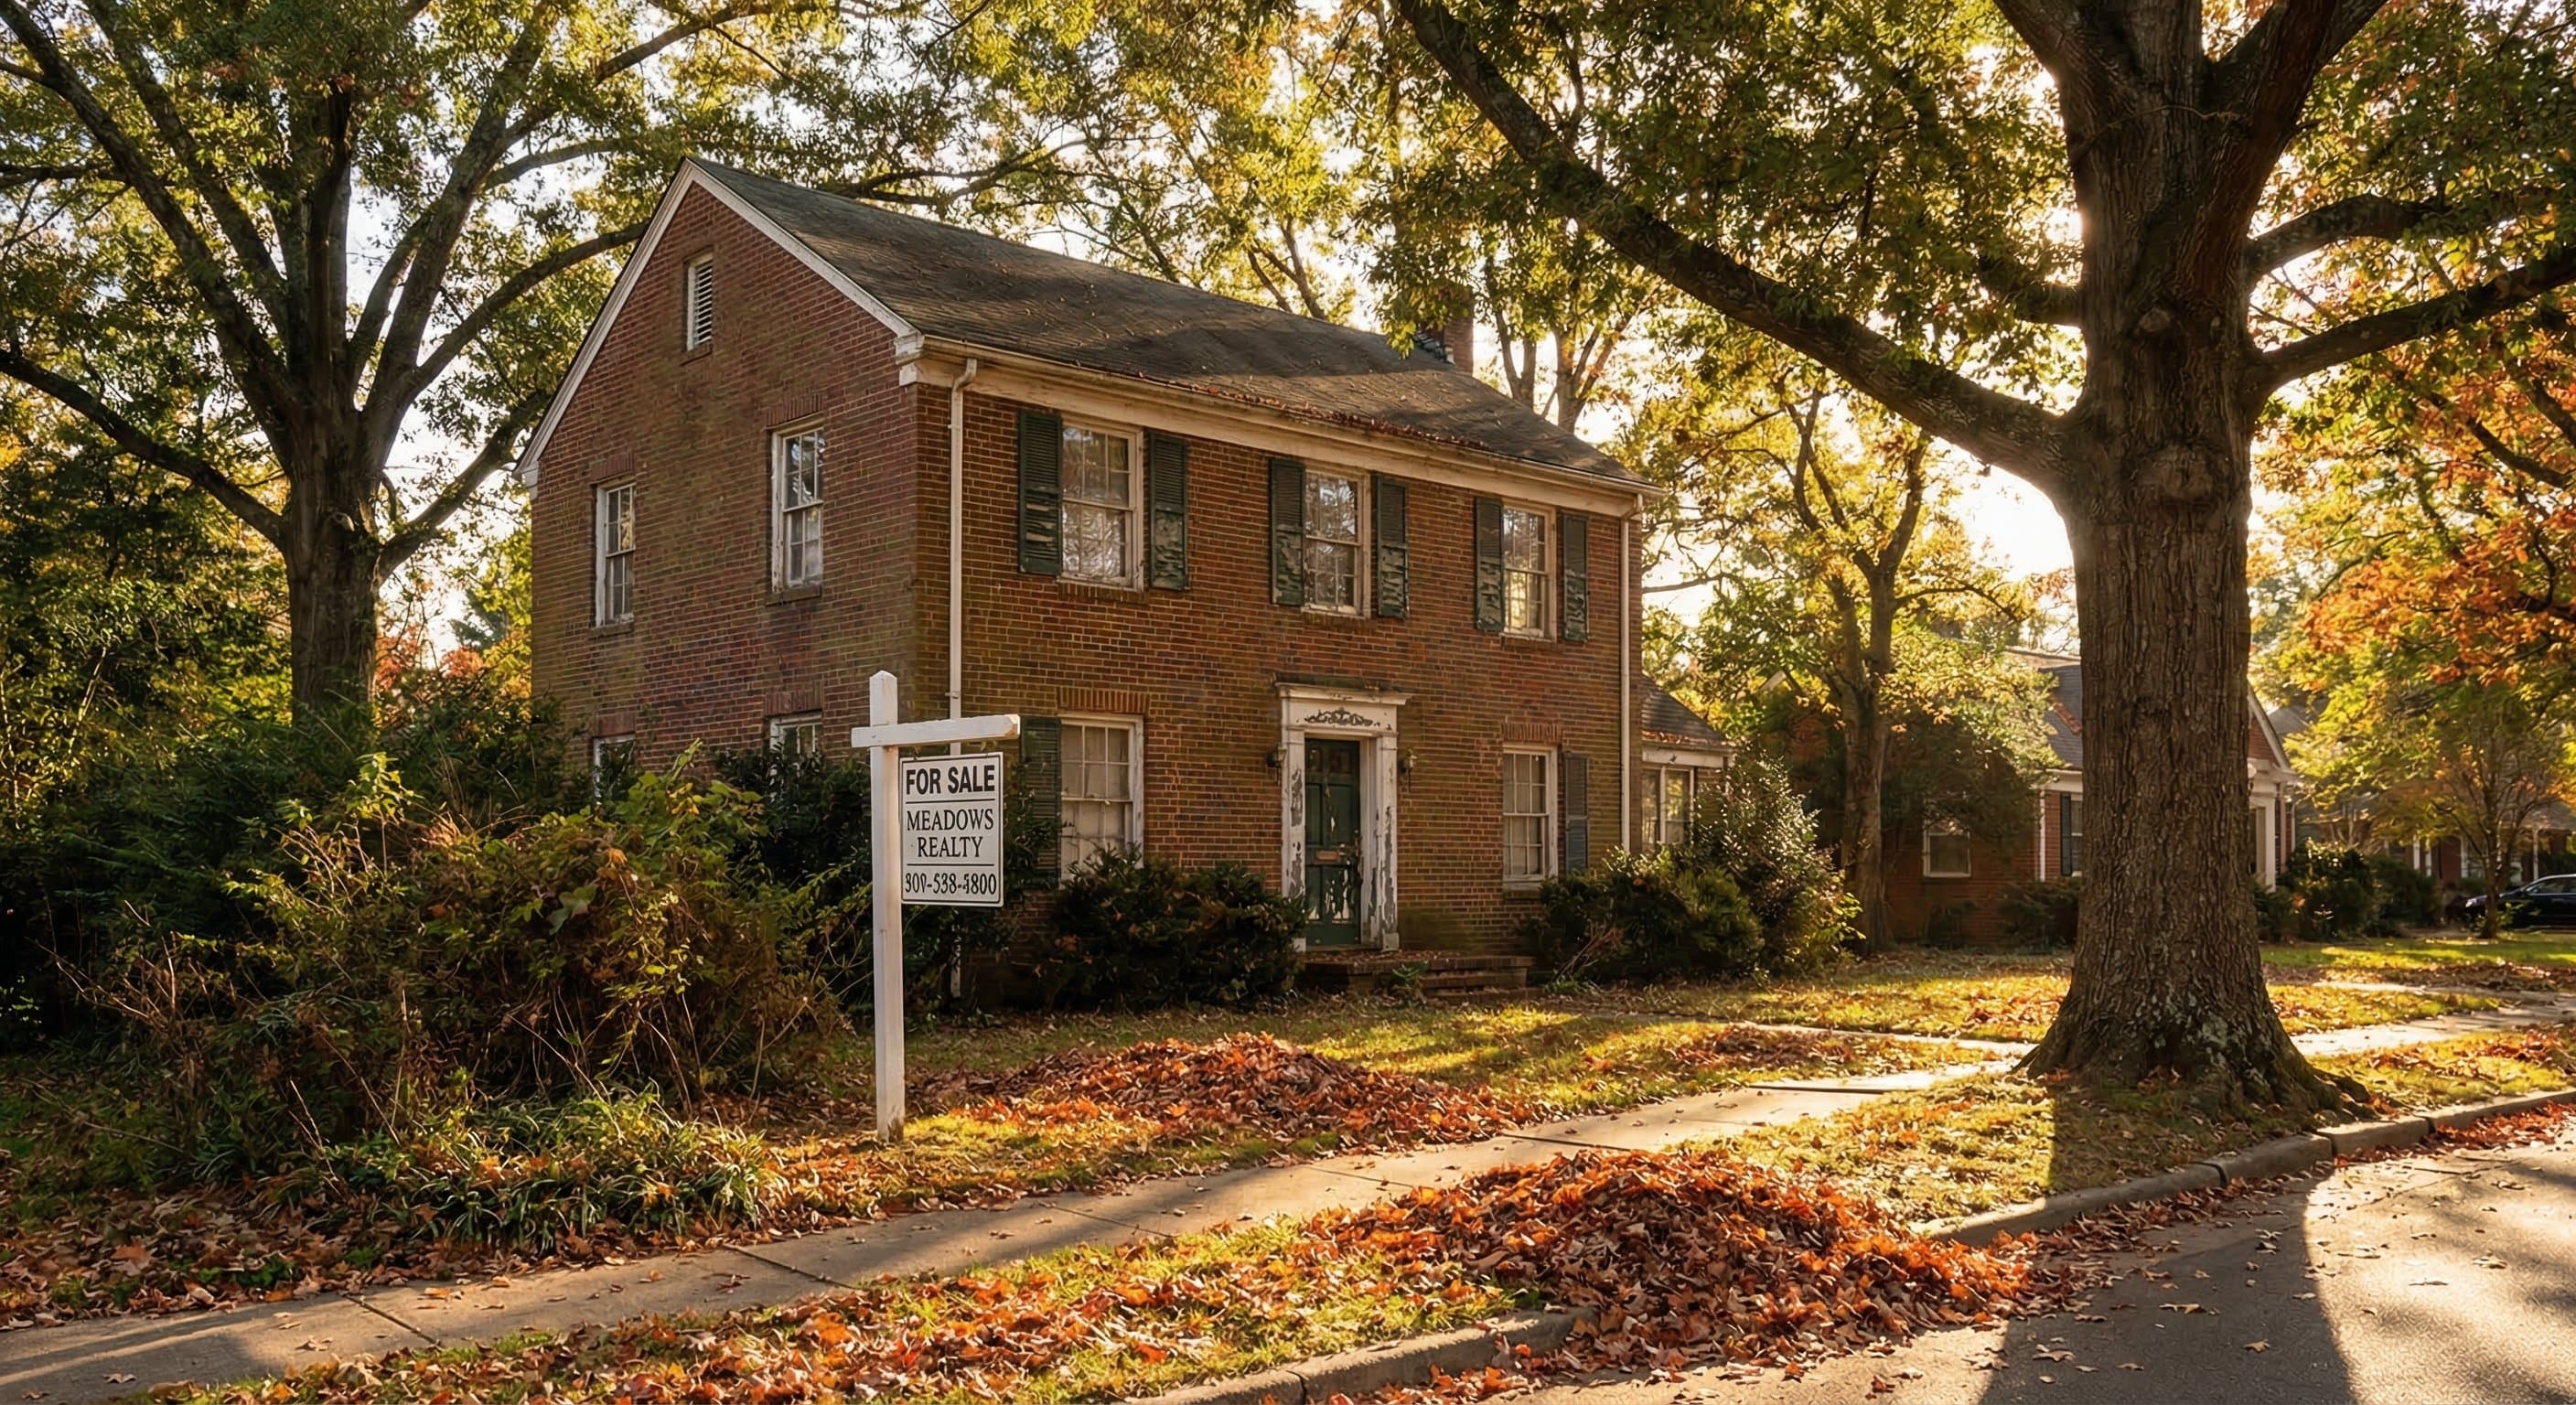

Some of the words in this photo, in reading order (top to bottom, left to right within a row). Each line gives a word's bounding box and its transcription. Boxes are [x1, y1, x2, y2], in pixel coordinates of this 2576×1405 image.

[906, 767, 942, 795] FOR
[947, 765, 995, 794] SALE
[907, 809, 994, 831] MEADOWS
[917, 836, 983, 858] REALTY
